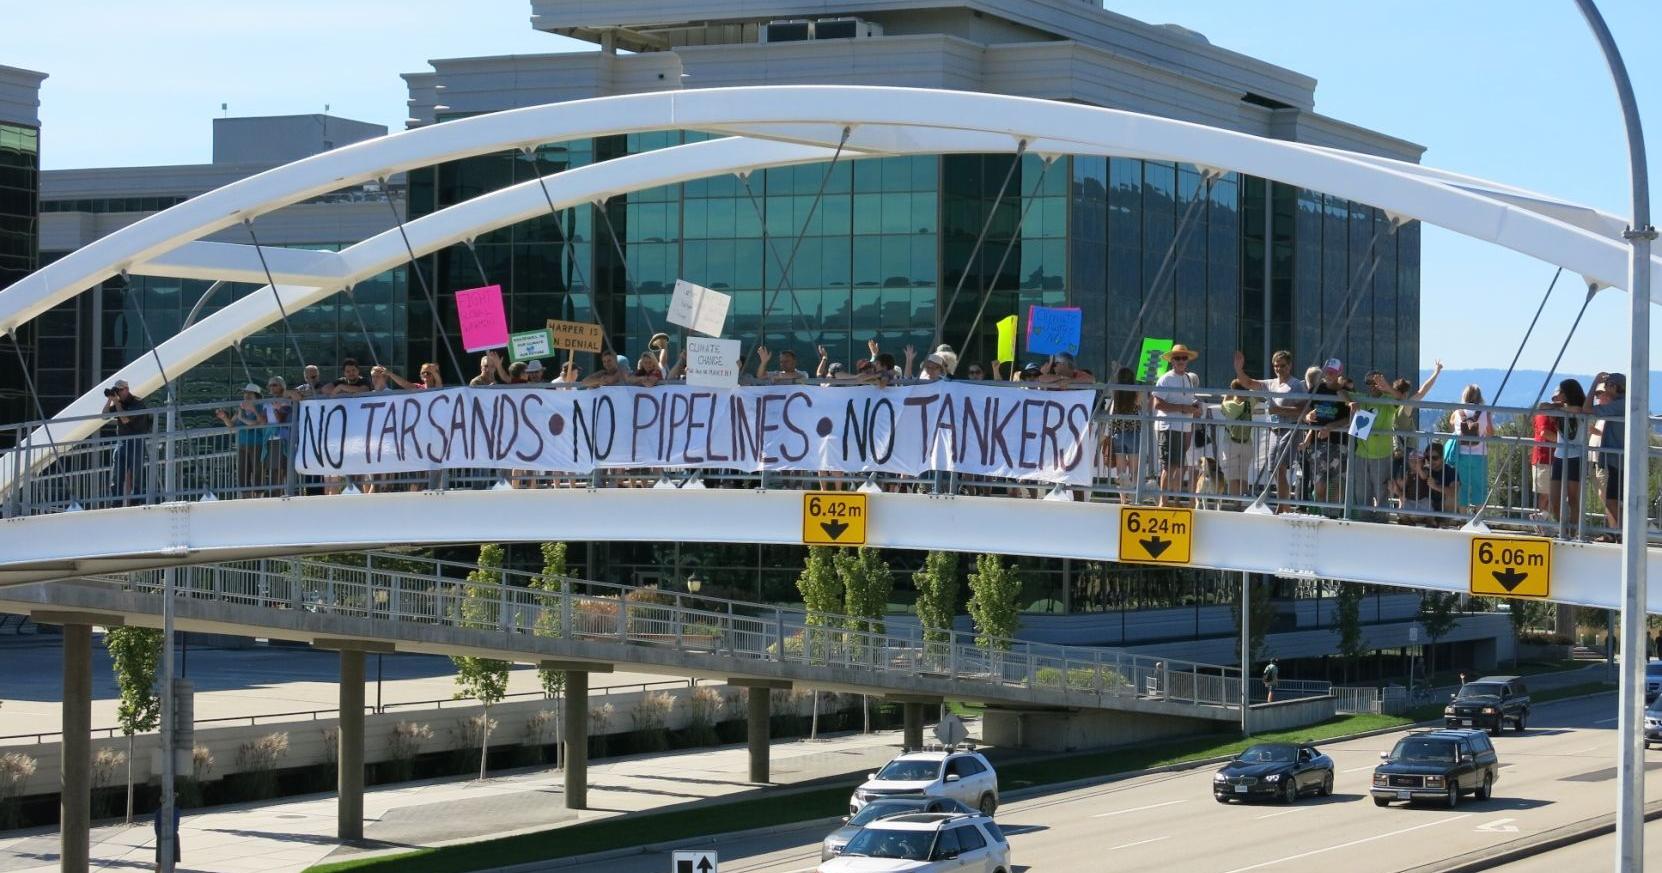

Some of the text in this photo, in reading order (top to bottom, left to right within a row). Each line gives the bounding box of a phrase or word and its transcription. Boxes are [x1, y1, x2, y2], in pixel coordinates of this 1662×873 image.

[549, 321, 599, 336] HARPER IS
[565, 339, 599, 350] DENIAL
[689, 343, 721, 354] CLIMATE
[697, 355, 723, 366] CHANGE
[302, 404, 347, 469] NO
[573, 395, 616, 463] NO
[632, 391, 814, 464] PIPELINES
[842, 397, 896, 465] NO
[903, 392, 1089, 472] TANKERS
